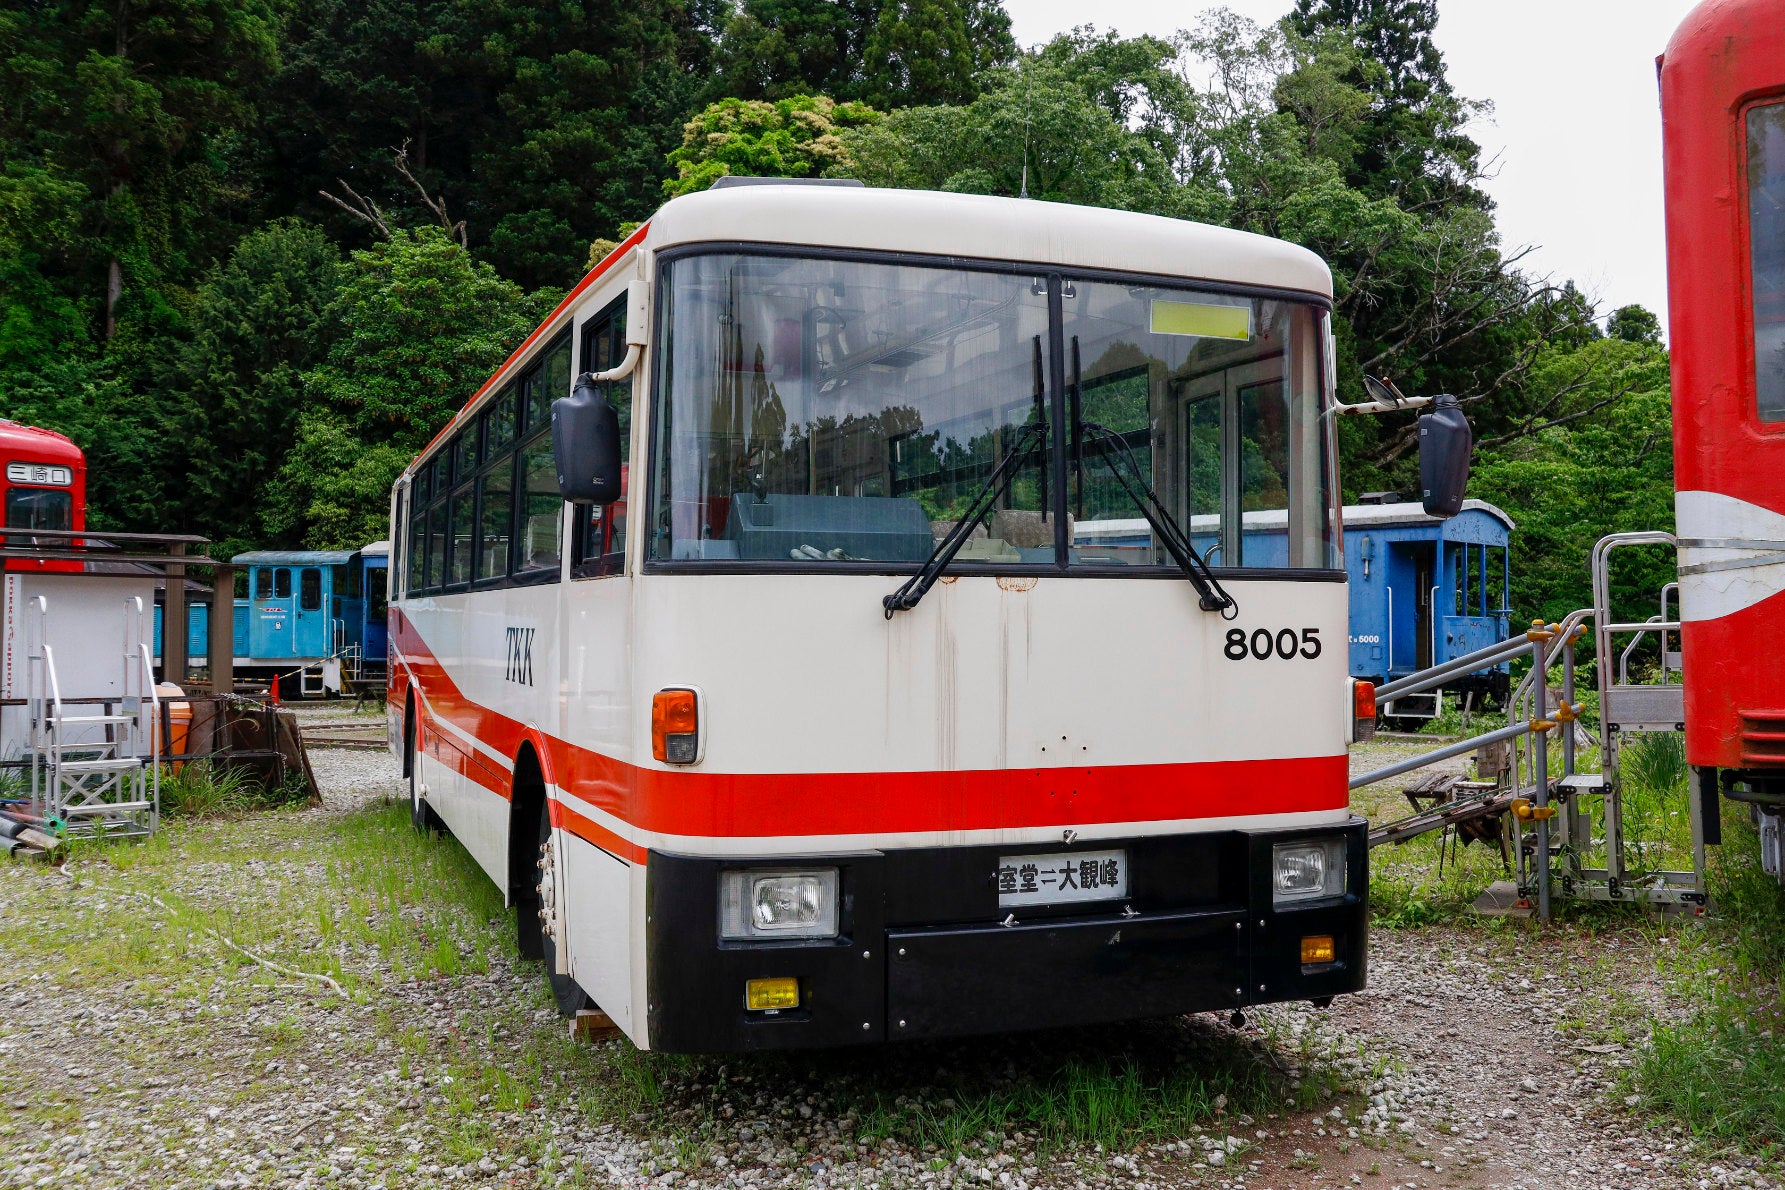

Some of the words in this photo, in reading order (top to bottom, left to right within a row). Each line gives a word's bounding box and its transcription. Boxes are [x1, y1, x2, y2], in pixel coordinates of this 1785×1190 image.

[10, 465, 66, 483] 三崎口
[506, 627, 535, 687] TKK
[1224, 628, 1322, 661] 8005
[999, 864, 1039, 894] 室堂
[1059, 859, 1119, 891] 大観峰
